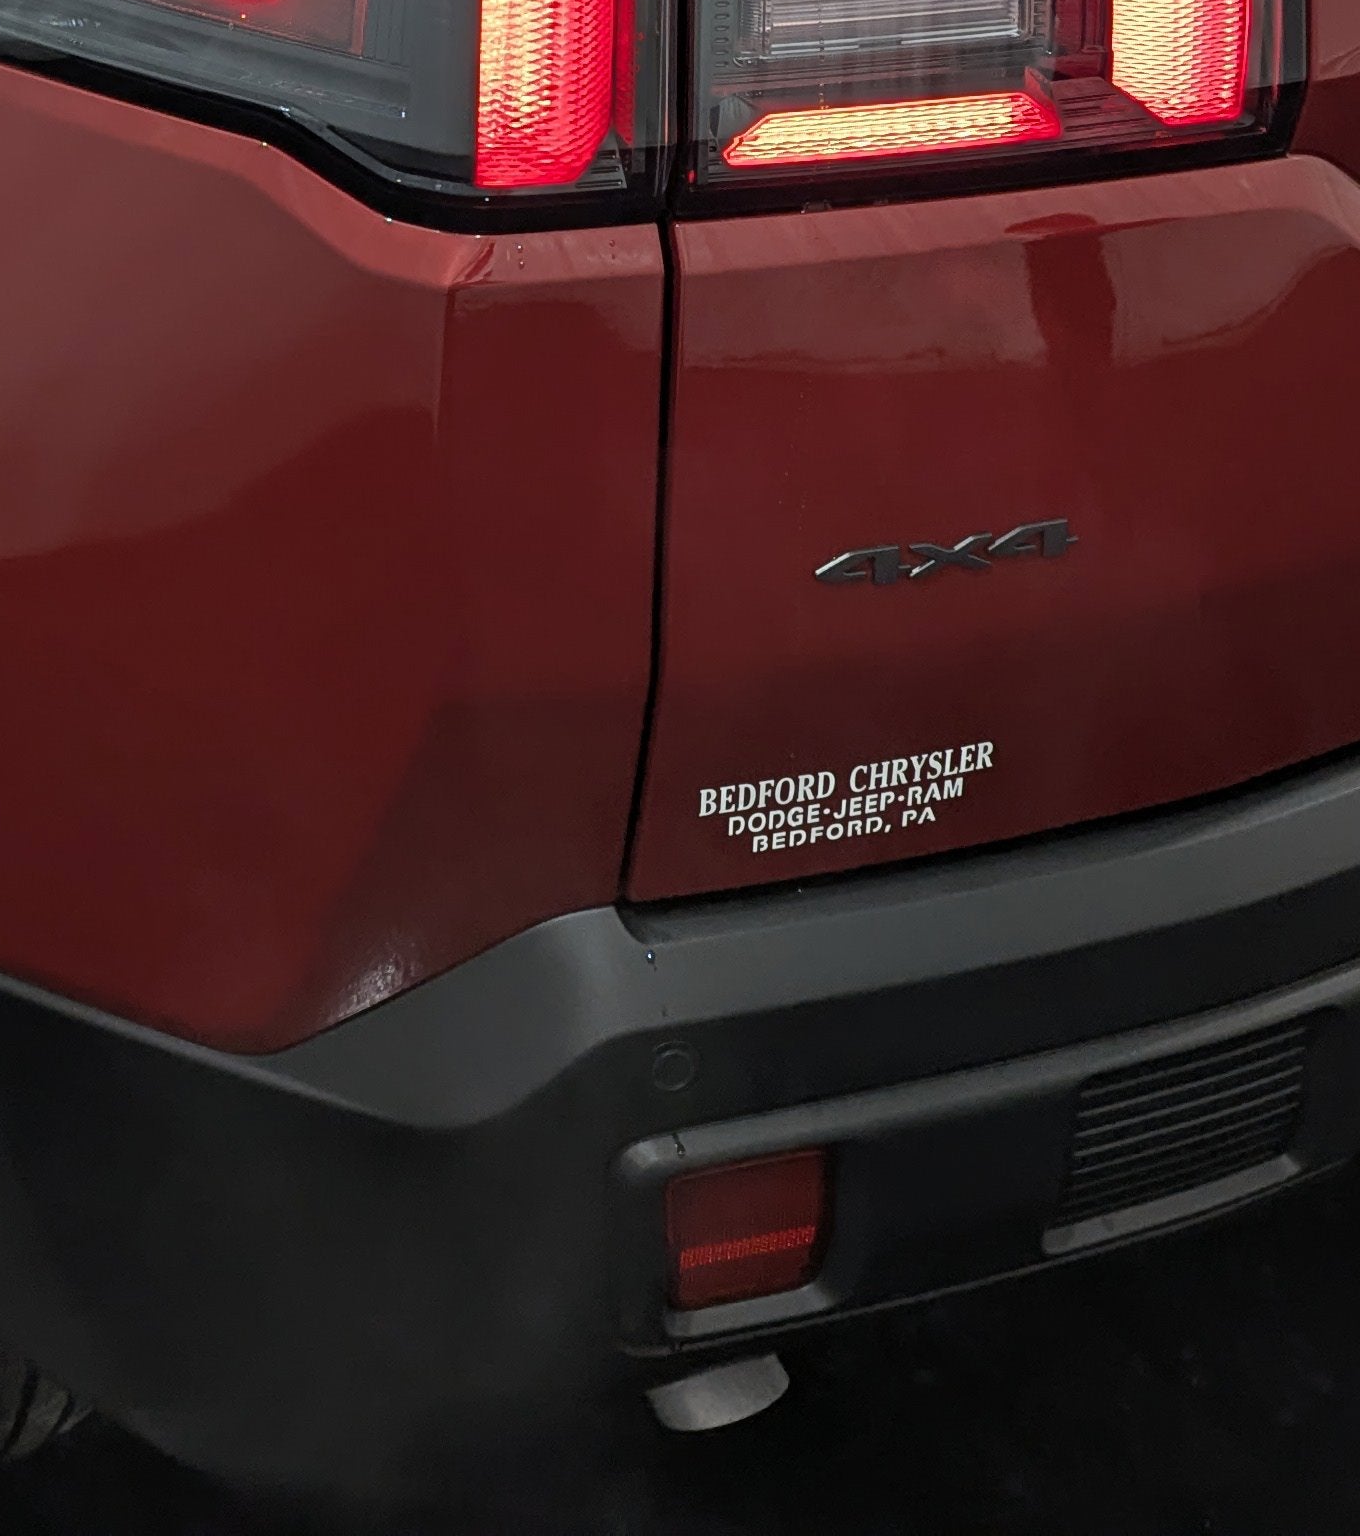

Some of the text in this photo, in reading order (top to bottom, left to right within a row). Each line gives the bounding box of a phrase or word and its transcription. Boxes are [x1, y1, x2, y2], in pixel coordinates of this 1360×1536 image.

[698, 741, 994, 817] BEDFORD CHRYSLER
[752, 806, 936, 853] BEDFORD, PA
